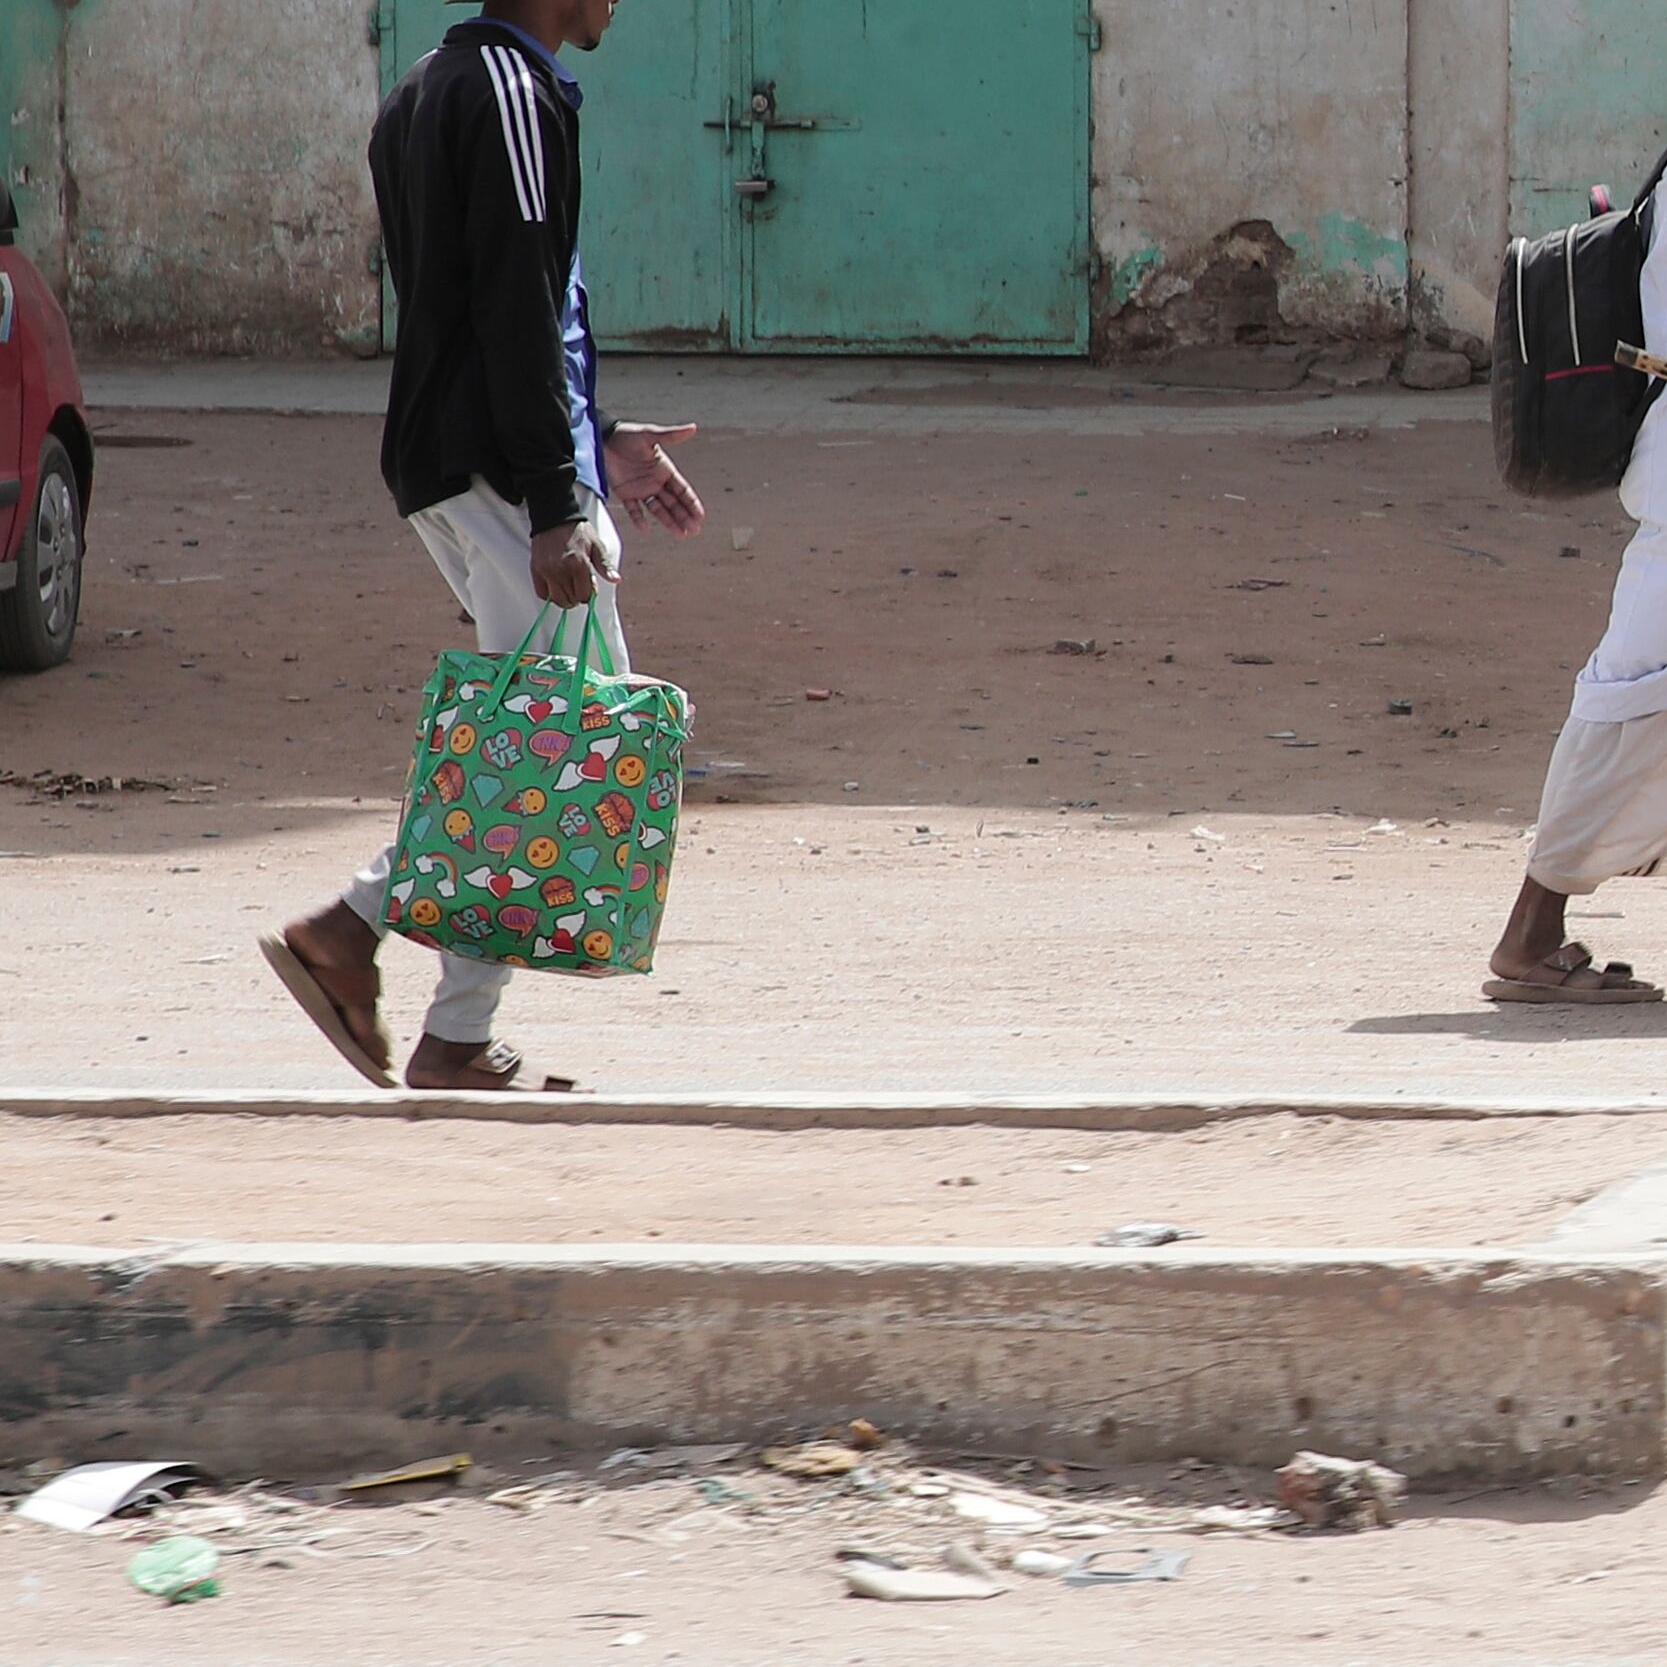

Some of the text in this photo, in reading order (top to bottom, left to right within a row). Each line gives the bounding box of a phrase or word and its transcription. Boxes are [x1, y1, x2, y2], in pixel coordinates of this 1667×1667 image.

[582, 715, 611, 730] KISS
[594, 803, 621, 837] KISS
[547, 891, 574, 908] KISS
